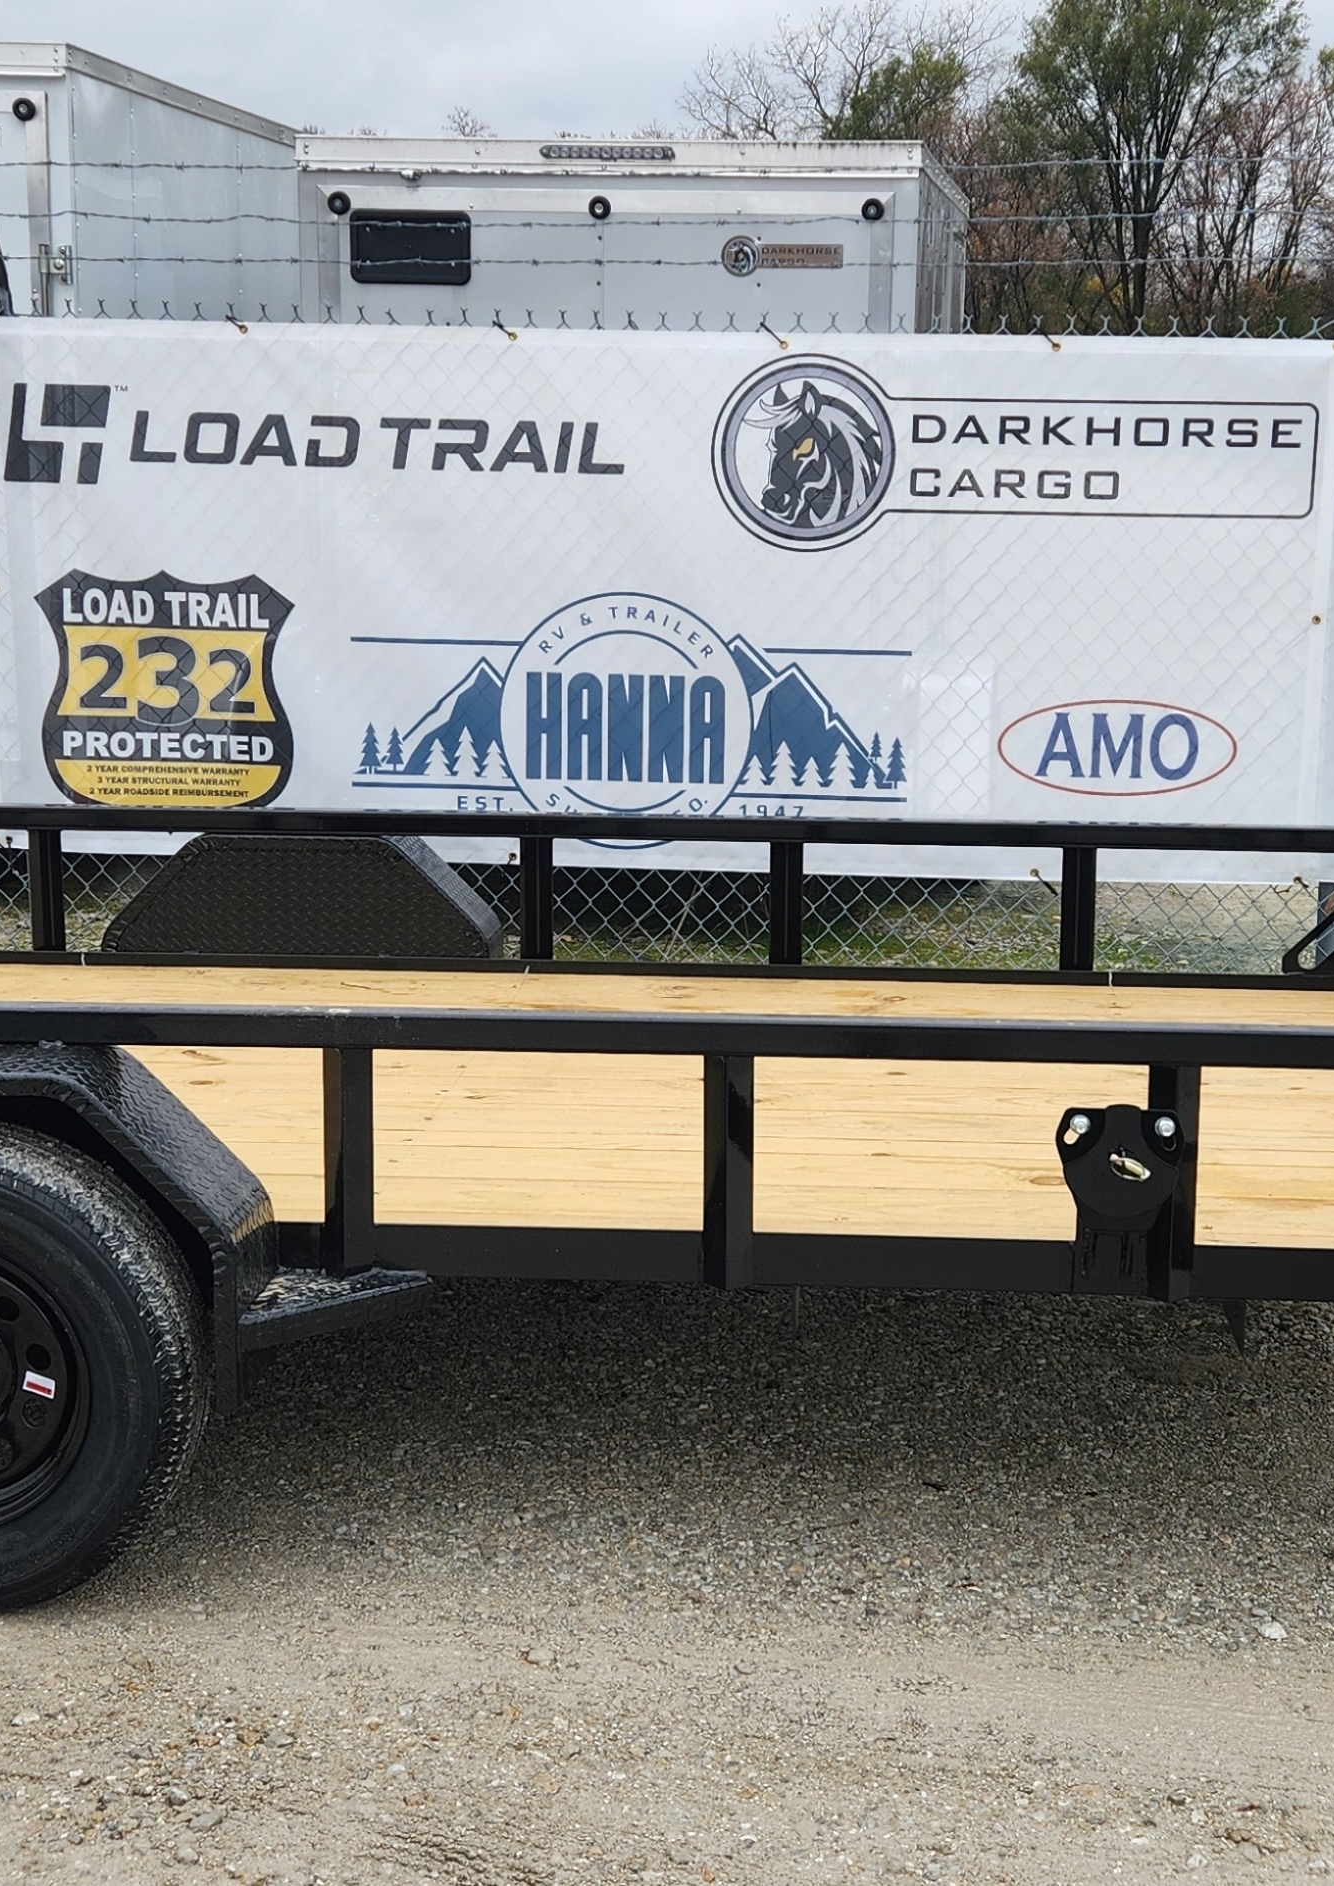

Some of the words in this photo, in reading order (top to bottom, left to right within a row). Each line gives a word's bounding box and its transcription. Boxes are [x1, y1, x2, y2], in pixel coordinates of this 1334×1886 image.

[761, 246, 841, 255] DARKHORSE
[130, 410, 361, 467] LOAD
[380, 417, 626, 475] TRAIL
[911, 414, 1303, 448] DARKHORSE
[909, 468, 1120, 500] CARGO
[62, 587, 155, 625] LOAD
[164, 591, 270, 628] TRAIL
[538, 626, 565, 654] RV
[579, 613, 593, 627] &
[608, 606, 715, 659] TRAILER
[78, 634, 258, 727] 232
[525, 671, 726, 785] HANNA
[62, 730, 275, 762] PROTECTED
[1035, 711, 1200, 781] AMO
[86, 764, 93, 773] 2
[95, 764, 120, 773] YEAR
[121, 765, 200, 775] COMPREHENSIVE
[201, 766, 250, 776] WARRANTY
[97, 776, 103, 784] 3
[104, 776, 129, 785] YEAR
[131, 777, 190, 786] STRUCTURAL
[191, 778, 241, 787] WARRANTY
[88, 787, 95, 795] 2
[97, 787, 122, 796] YEAR
[123, 787, 171, 797] ROADSIDE
[172, 788, 249, 798] REIMBURSEMENT
[457, 795, 514, 812] EST.
[738, 804, 804, 818] 1947
